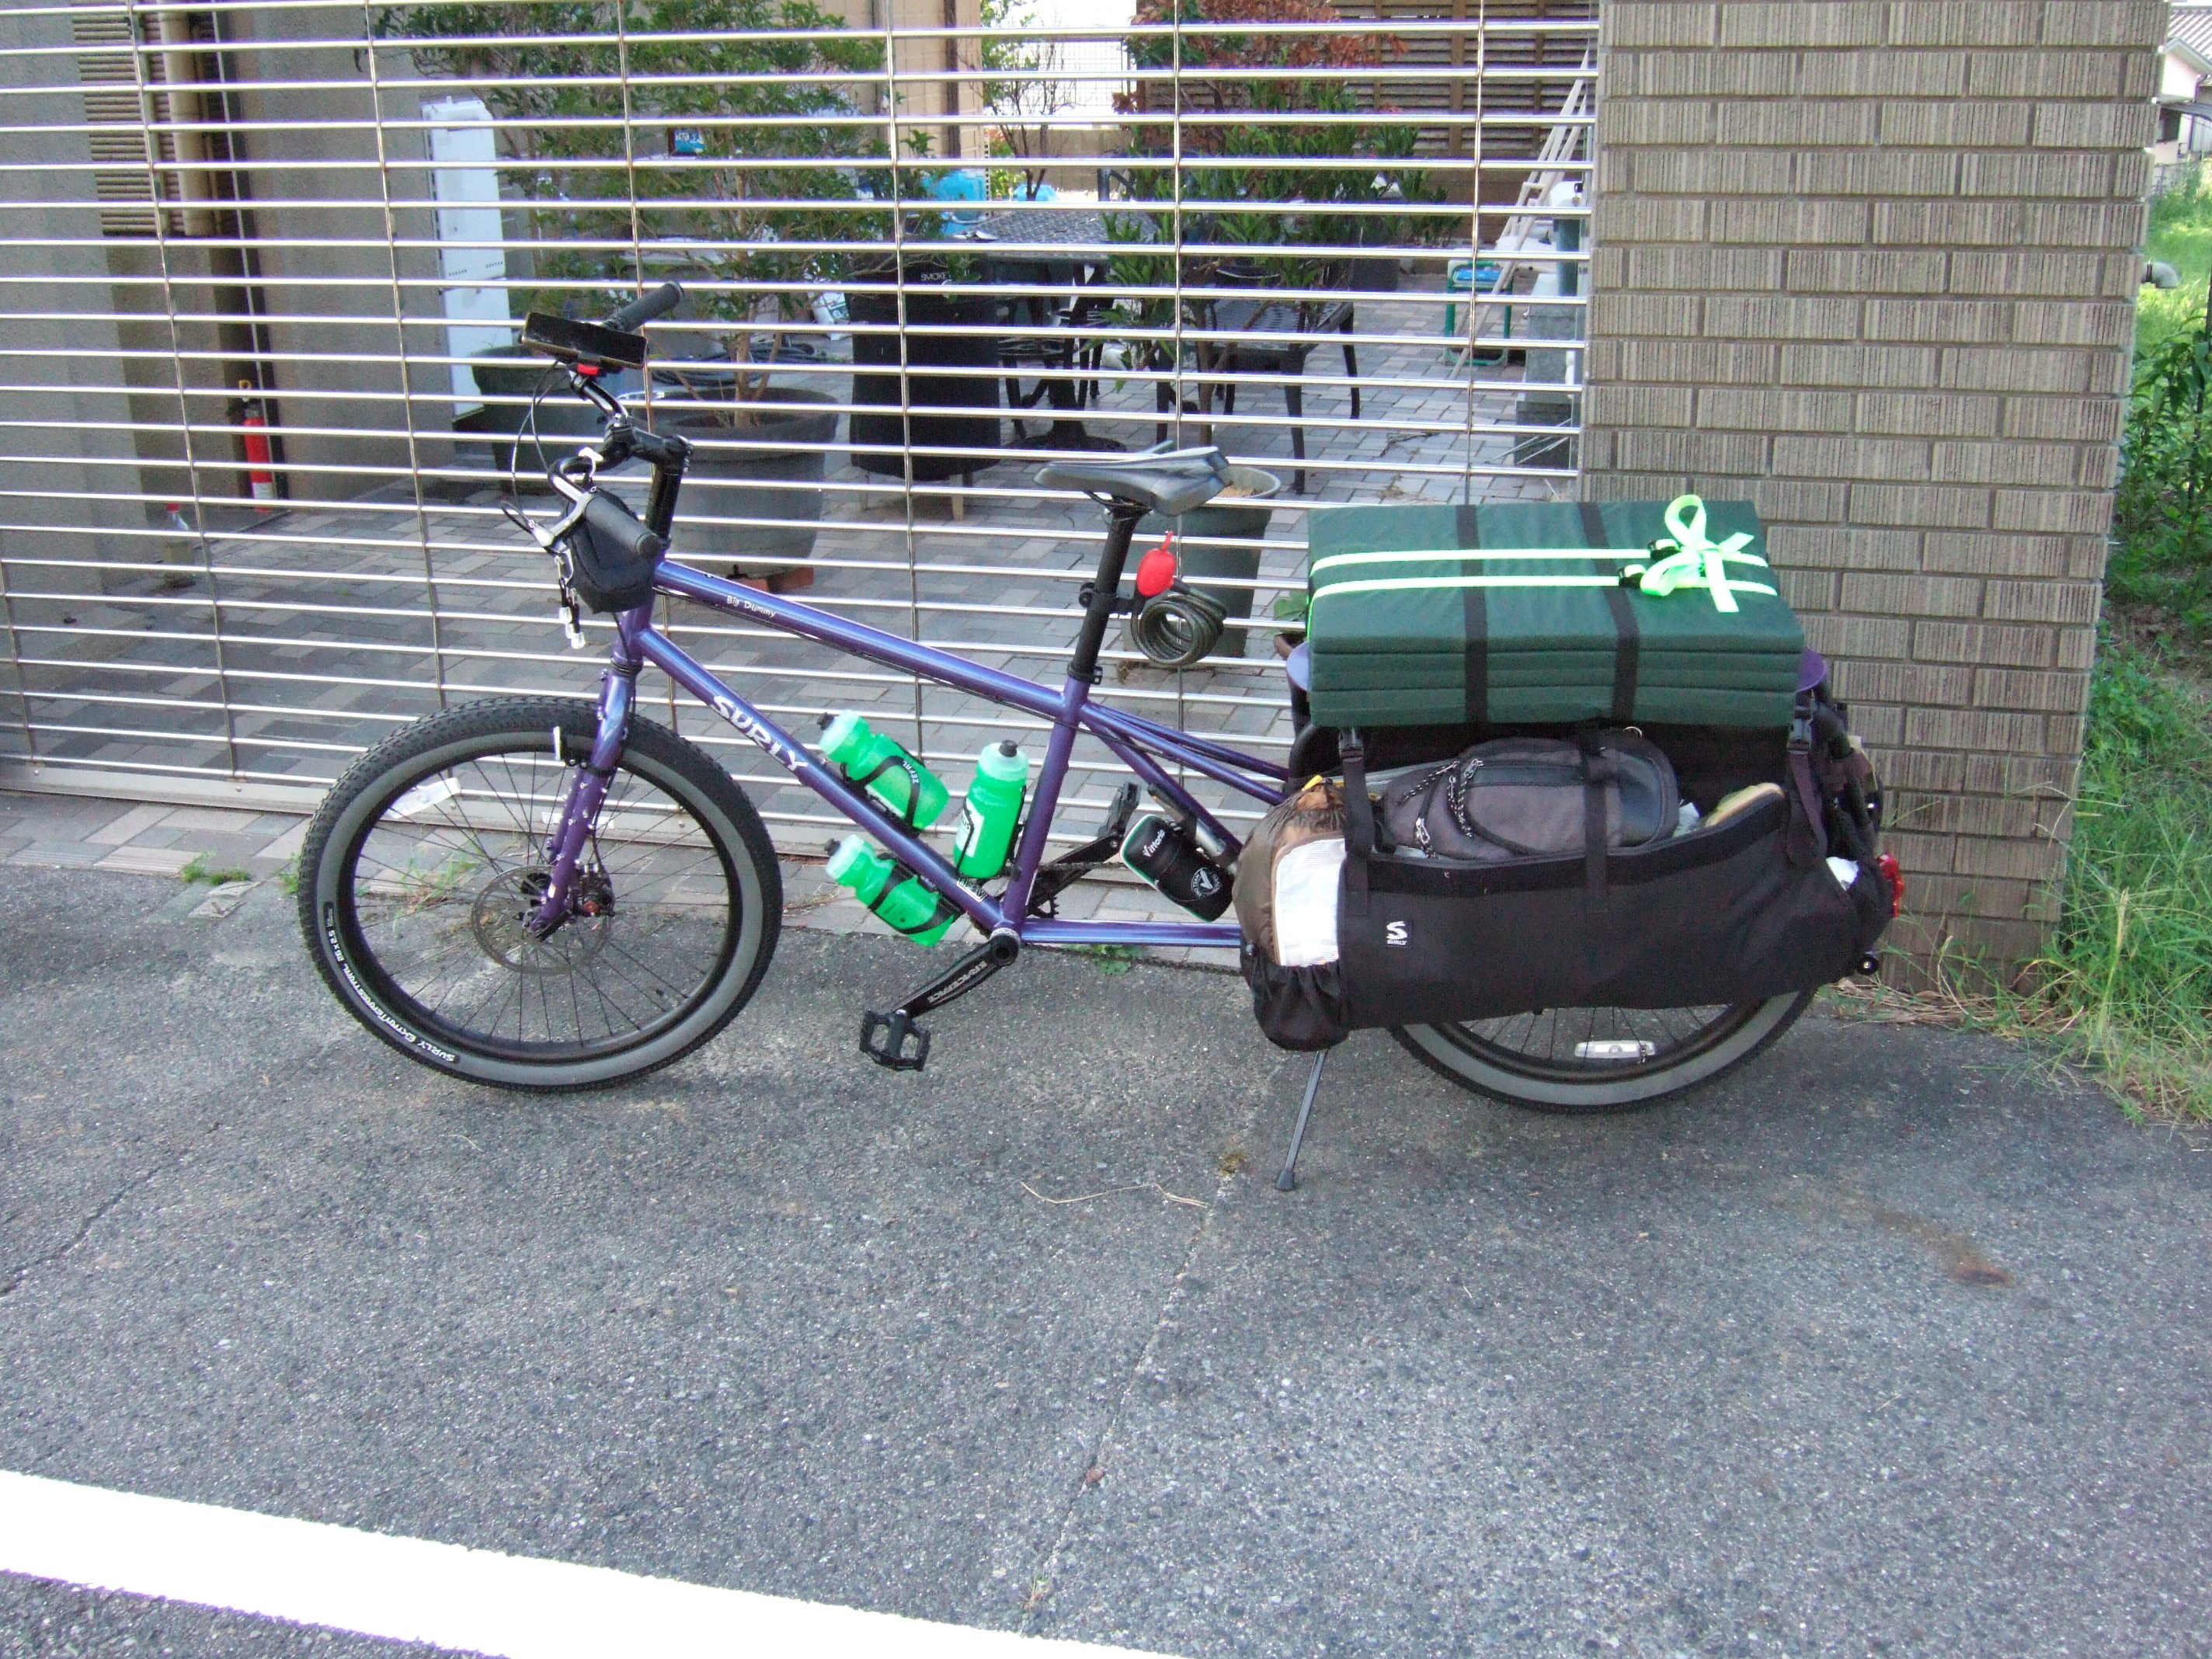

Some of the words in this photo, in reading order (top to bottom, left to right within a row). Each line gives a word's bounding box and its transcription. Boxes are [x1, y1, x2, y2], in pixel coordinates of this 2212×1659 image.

[727, 595, 740, 607] Big
[744, 600, 777, 618] Dummy
[710, 695, 809, 771] SURLY
[903, 760, 920, 784] ZEFAL
[1143, 830, 1165, 857] Vittoria
[417, 1040, 456, 1062] SURLY
